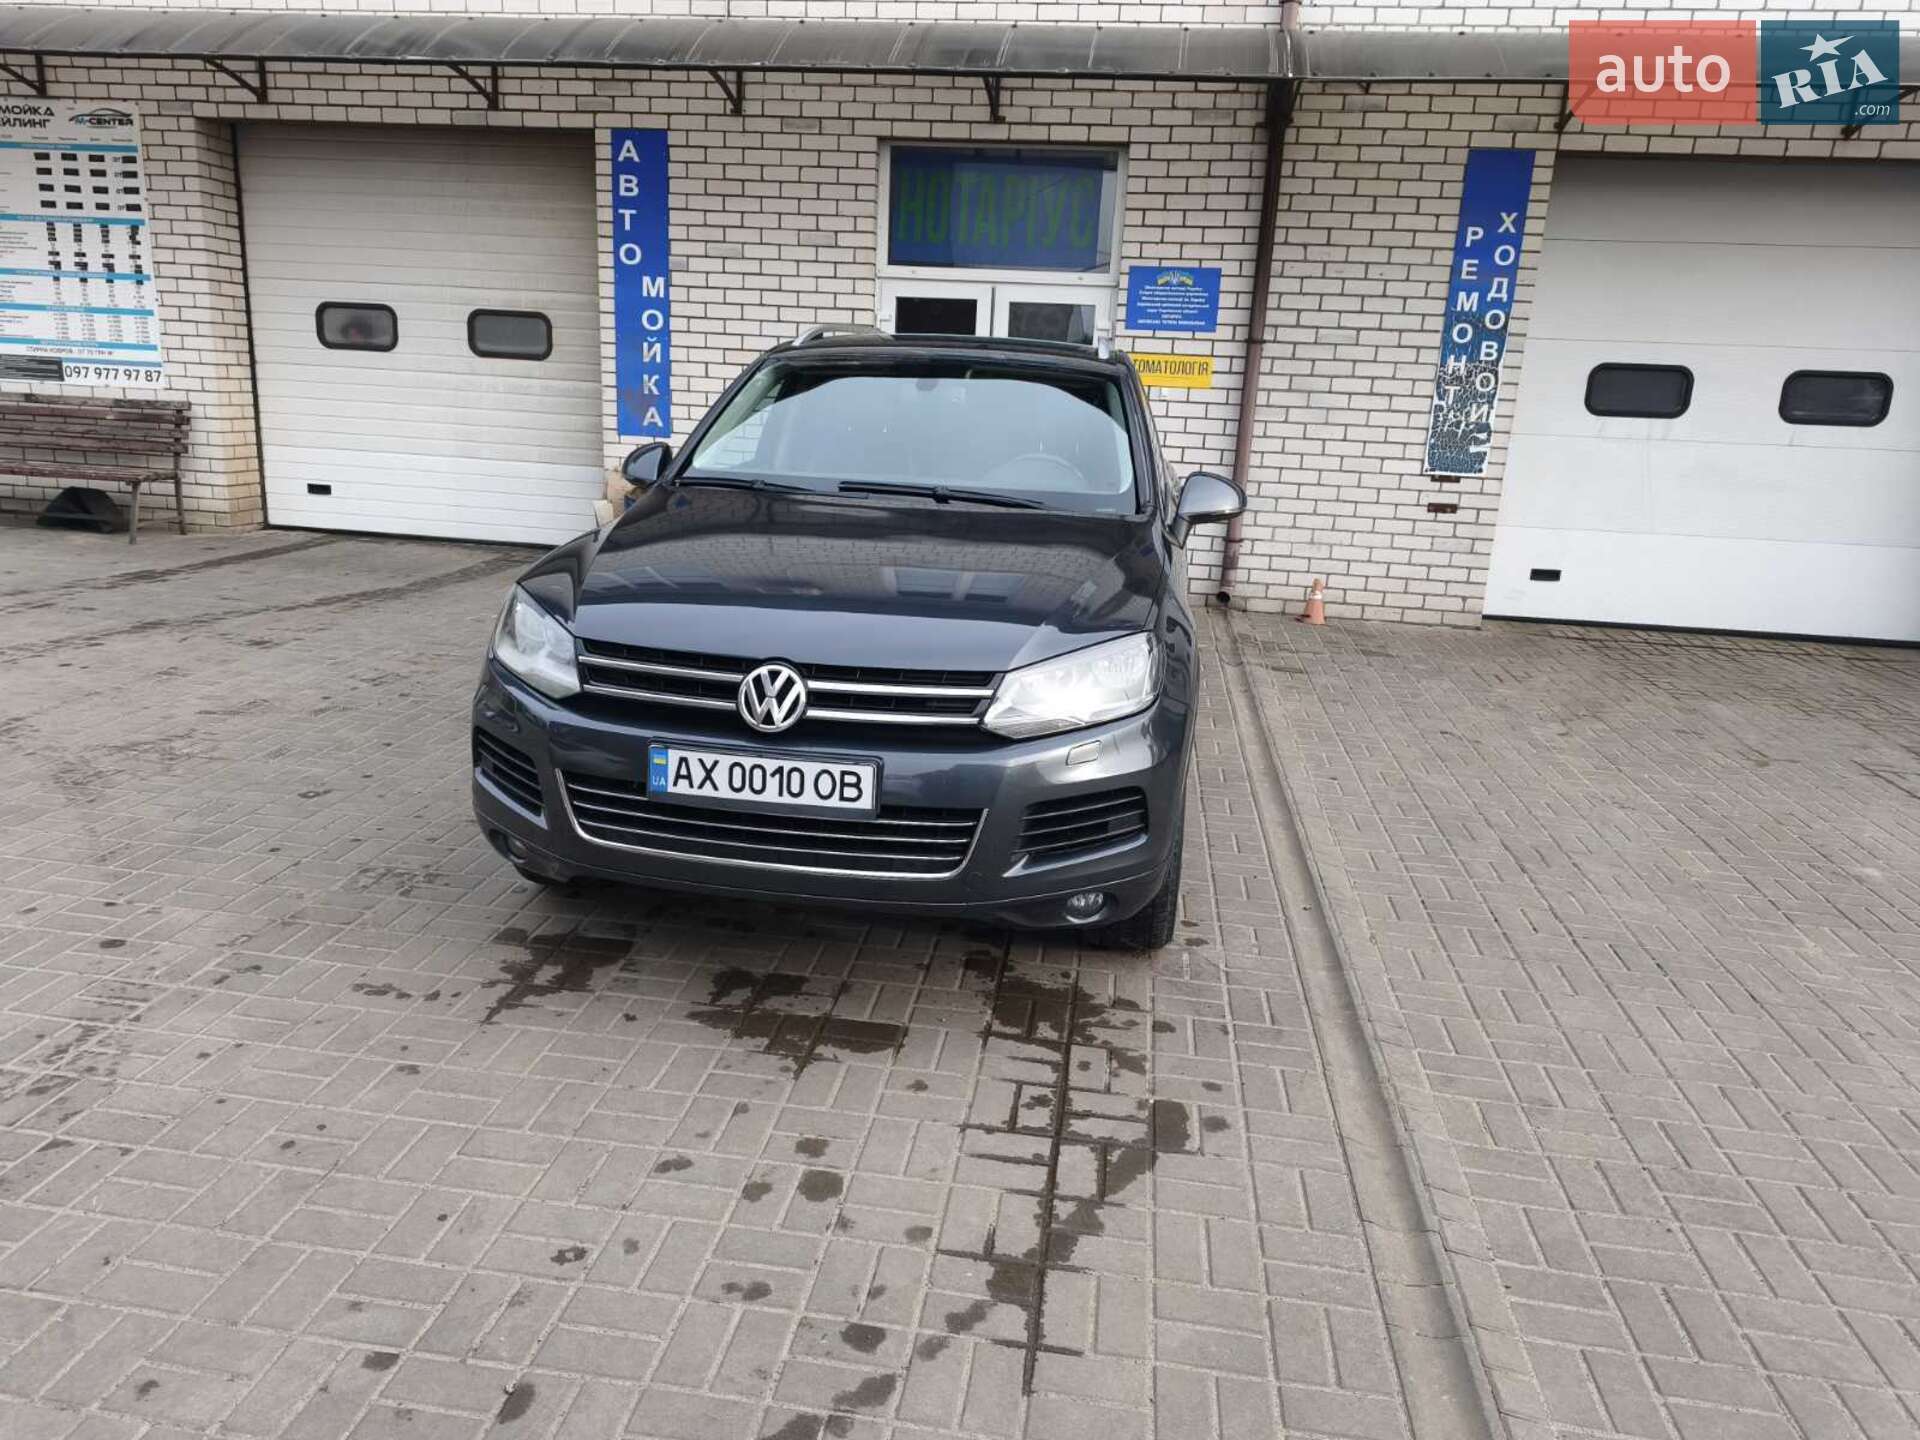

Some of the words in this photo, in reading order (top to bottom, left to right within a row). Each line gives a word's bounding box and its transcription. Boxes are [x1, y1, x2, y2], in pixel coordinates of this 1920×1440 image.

[0, 115, 51, 129] ЙЛИНГ
[64, 365, 90, 379] 097
[94, 367, 119, 380] 977
[123, 369, 141, 381] 97
[144, 370, 162, 382] 87
[1133, 358, 1209, 377] ТОМАТОЛОГІЯ
[652, 775, 666, 786] UA
[672, 756, 720, 791] AX
[728, 761, 805, 798] 0010
[813, 769, 863, 803] OB
